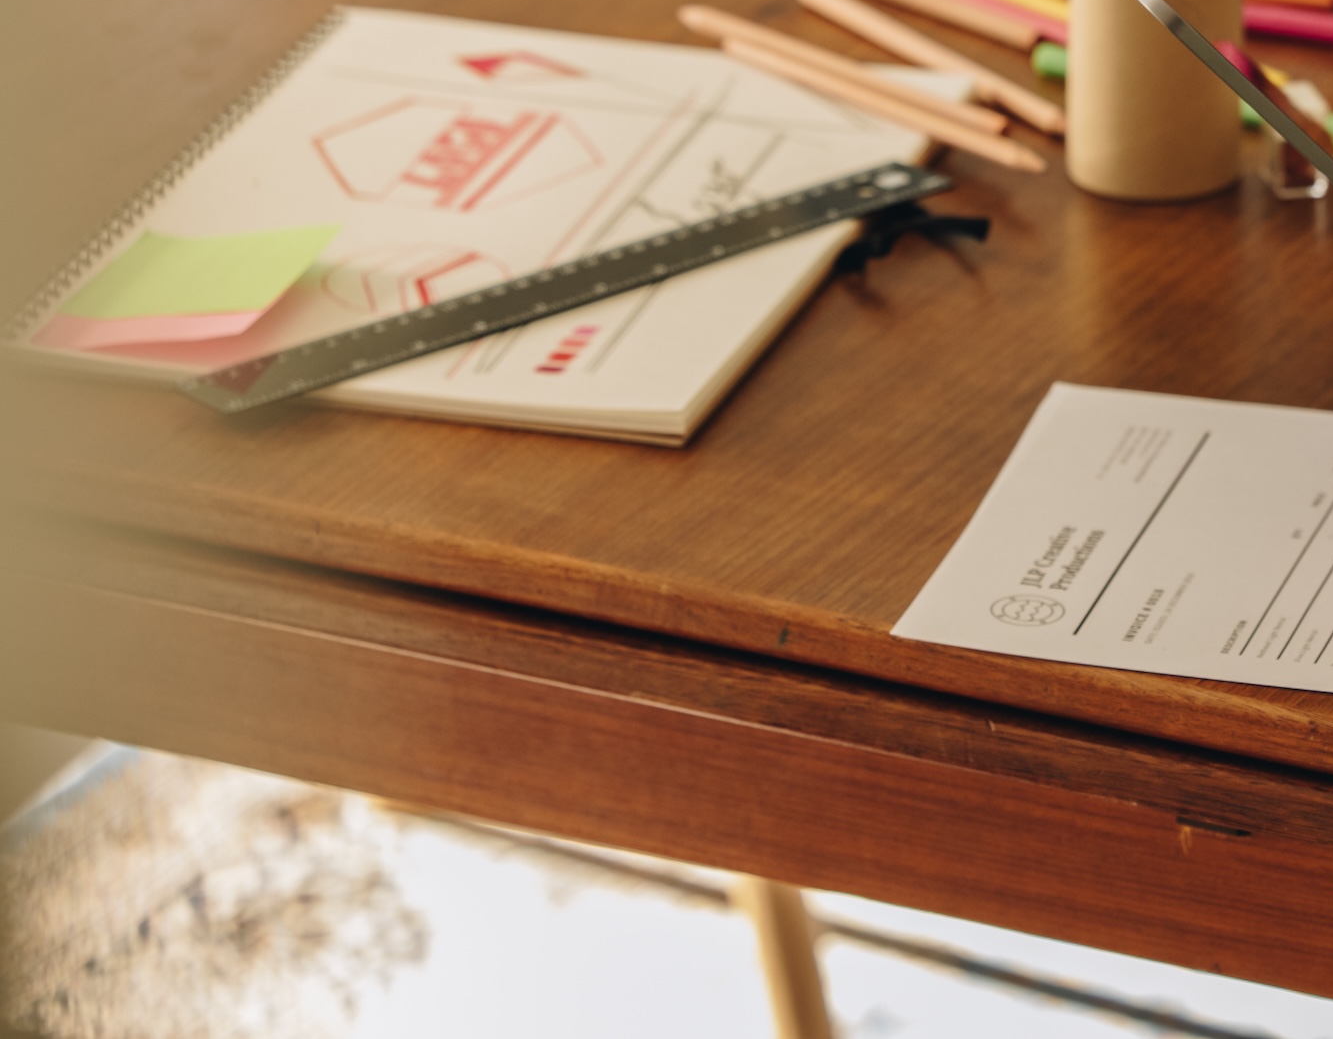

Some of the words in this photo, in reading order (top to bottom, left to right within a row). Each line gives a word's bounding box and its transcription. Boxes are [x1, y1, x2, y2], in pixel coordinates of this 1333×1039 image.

[1019, 567, 1045, 589] JLP
[1033, 525, 1076, 568] Creative
[1048, 528, 1105, 591] Productions
[1122, 612, 1149, 642] INVOICE
